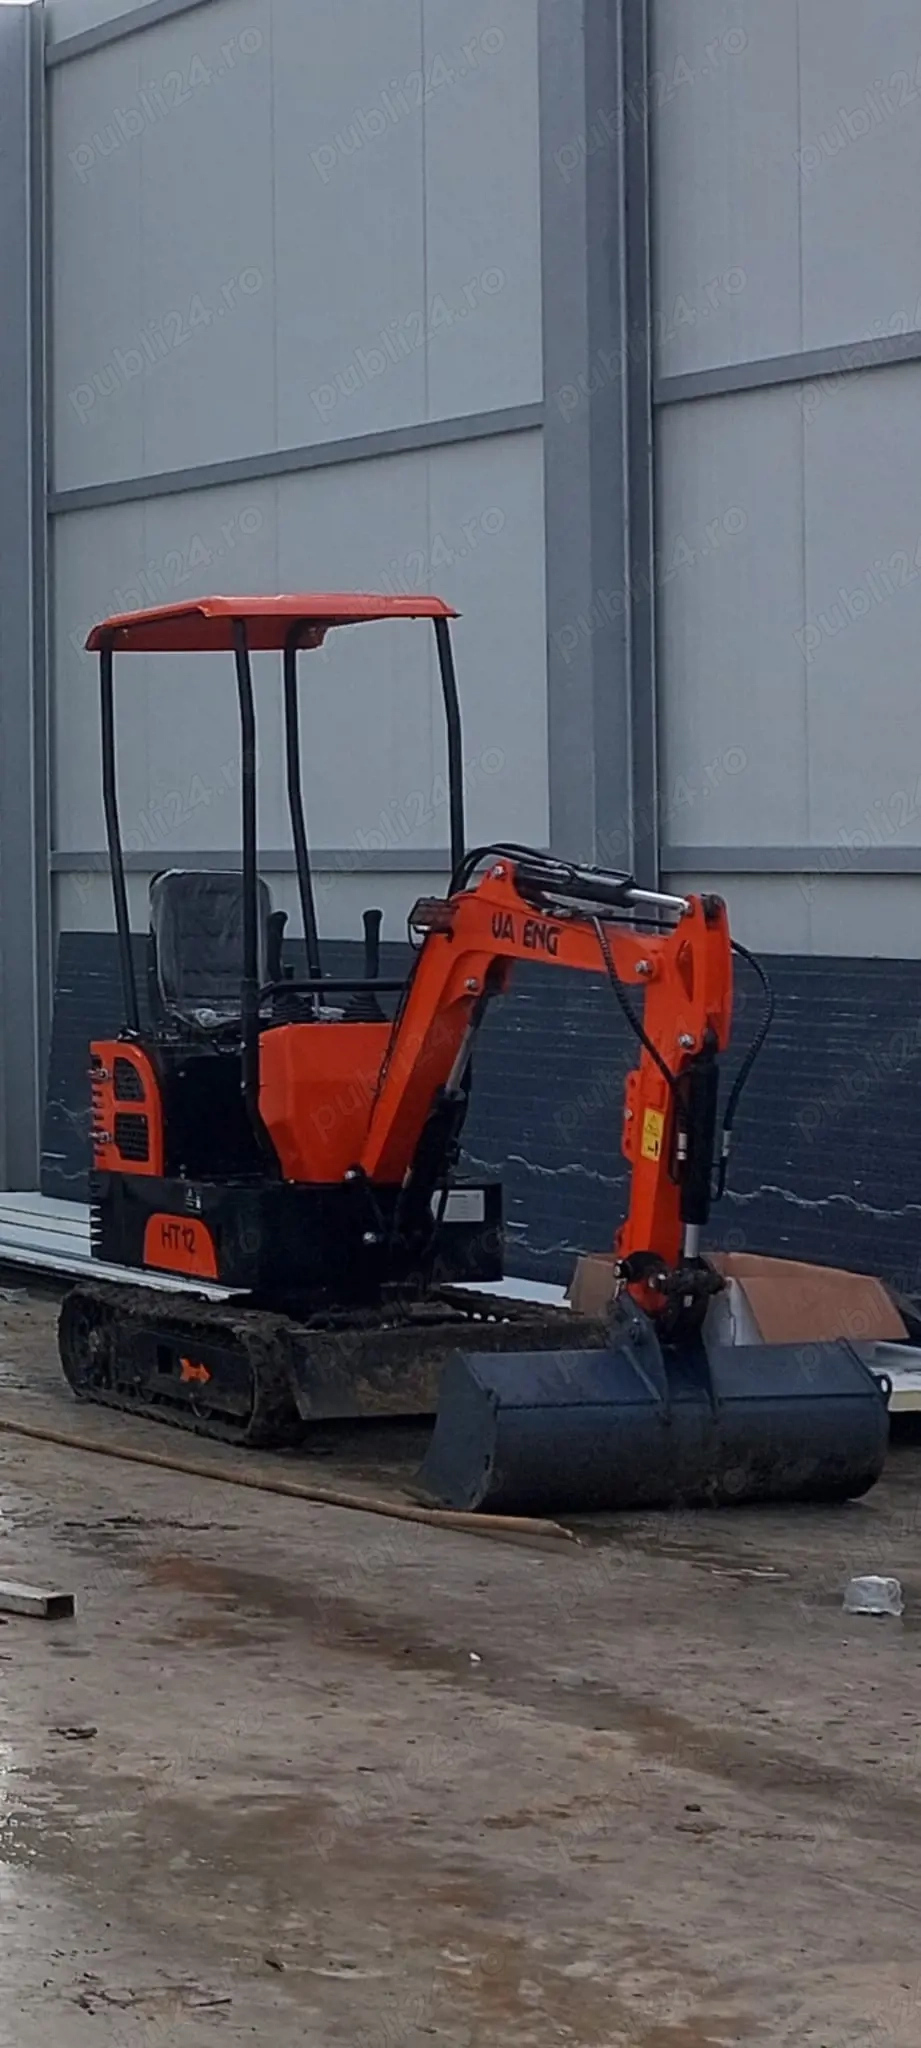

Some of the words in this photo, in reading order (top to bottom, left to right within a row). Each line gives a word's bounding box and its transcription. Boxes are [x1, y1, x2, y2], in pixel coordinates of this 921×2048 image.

[492, 910, 515, 944] UA
[523, 918, 561, 956] ENG
[161, 1222, 197, 1255] HT12
